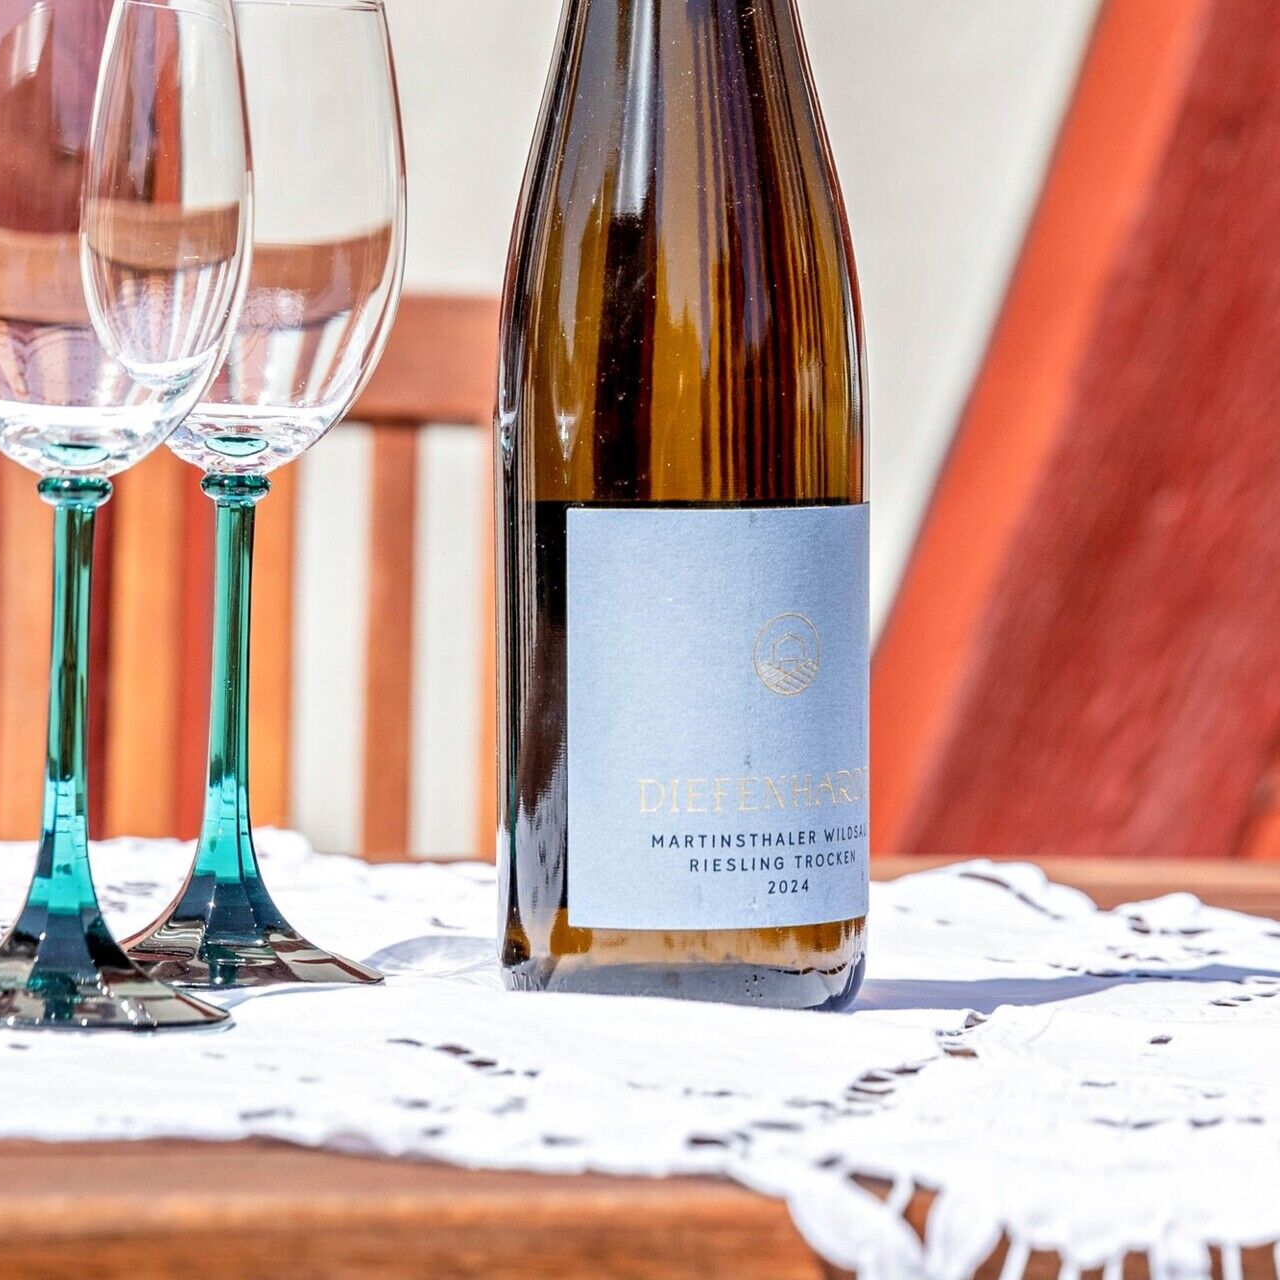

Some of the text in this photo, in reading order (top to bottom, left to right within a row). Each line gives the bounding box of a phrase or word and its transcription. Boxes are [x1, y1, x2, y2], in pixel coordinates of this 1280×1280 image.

[651, 830, 816, 848] MARTINSTHALER
[689, 850, 856, 872] RIESLING TROCKEN
[767, 878, 810, 895] 2024
